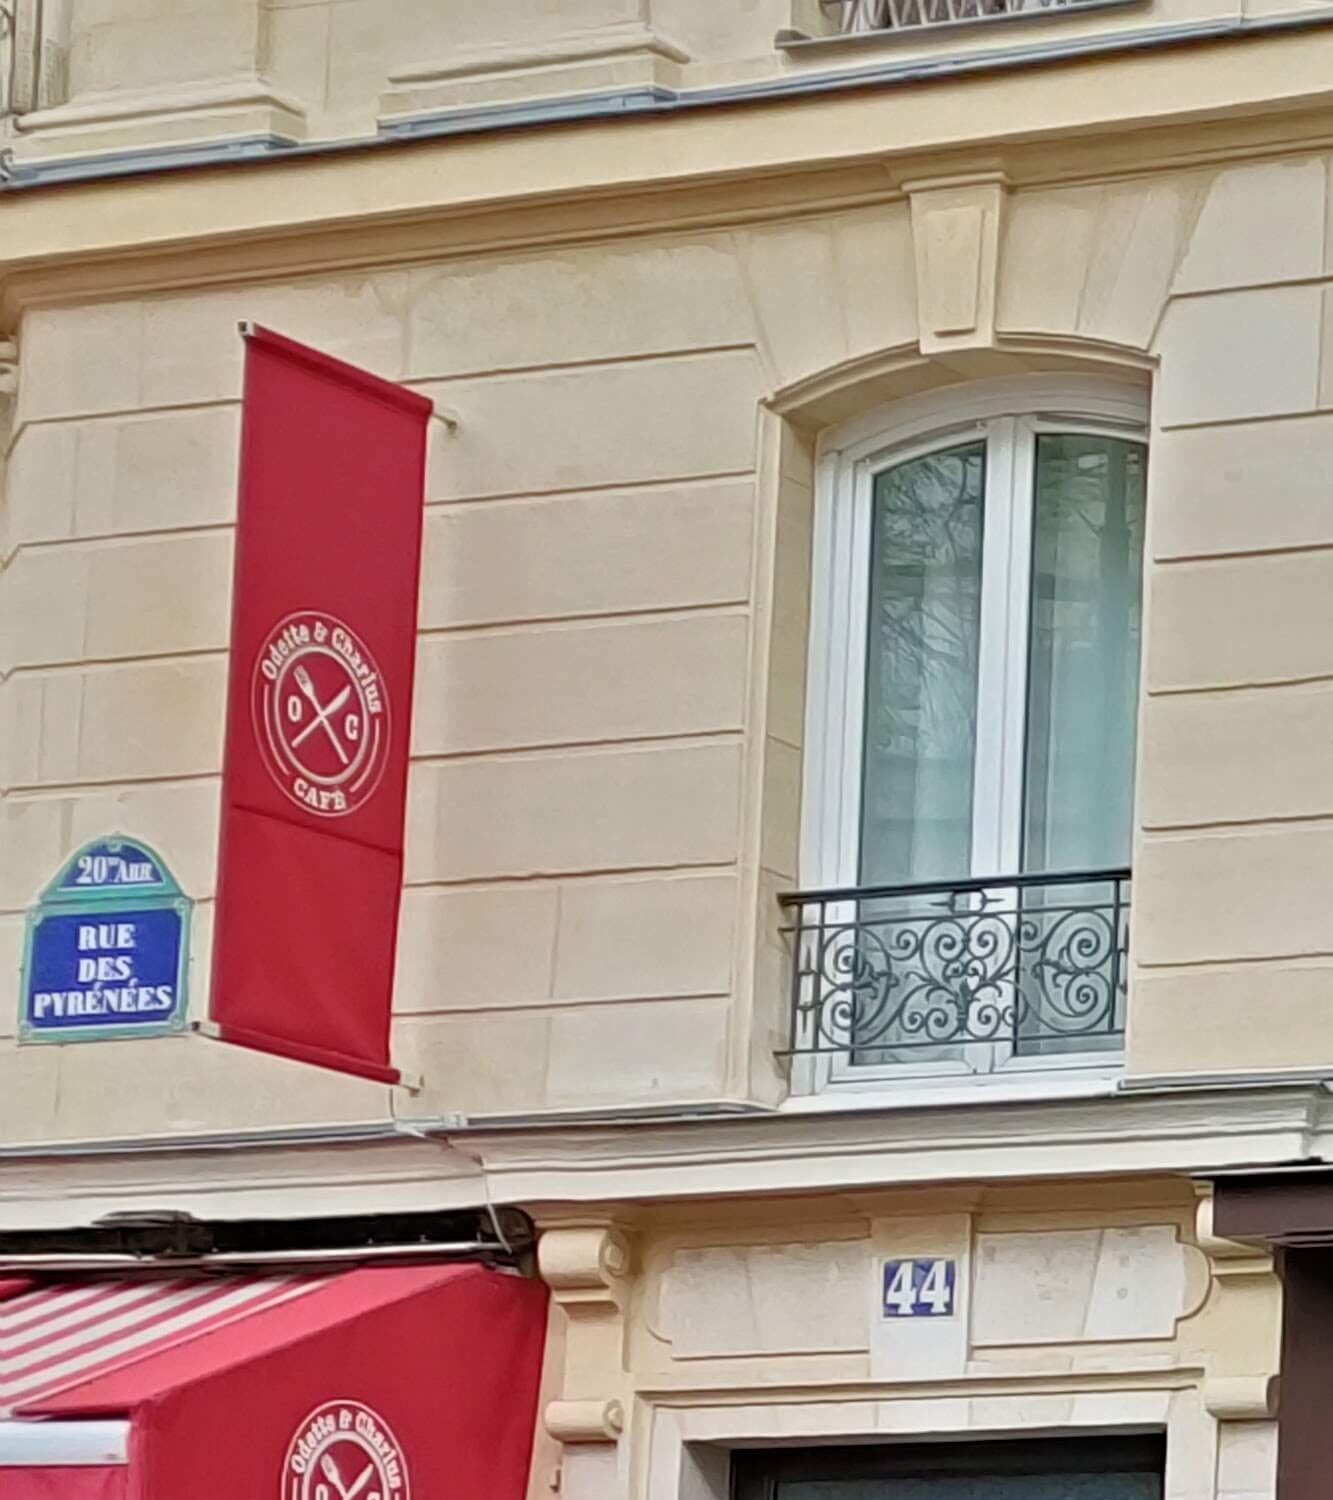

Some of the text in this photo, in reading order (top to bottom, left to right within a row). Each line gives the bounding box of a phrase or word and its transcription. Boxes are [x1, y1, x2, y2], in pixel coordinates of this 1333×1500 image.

[78, 924, 136, 951] RUE
[78, 956, 132, 983] DES
[33, 978, 173, 1018] PYRÉNÉES
[886, 1259, 951, 1315] 44
